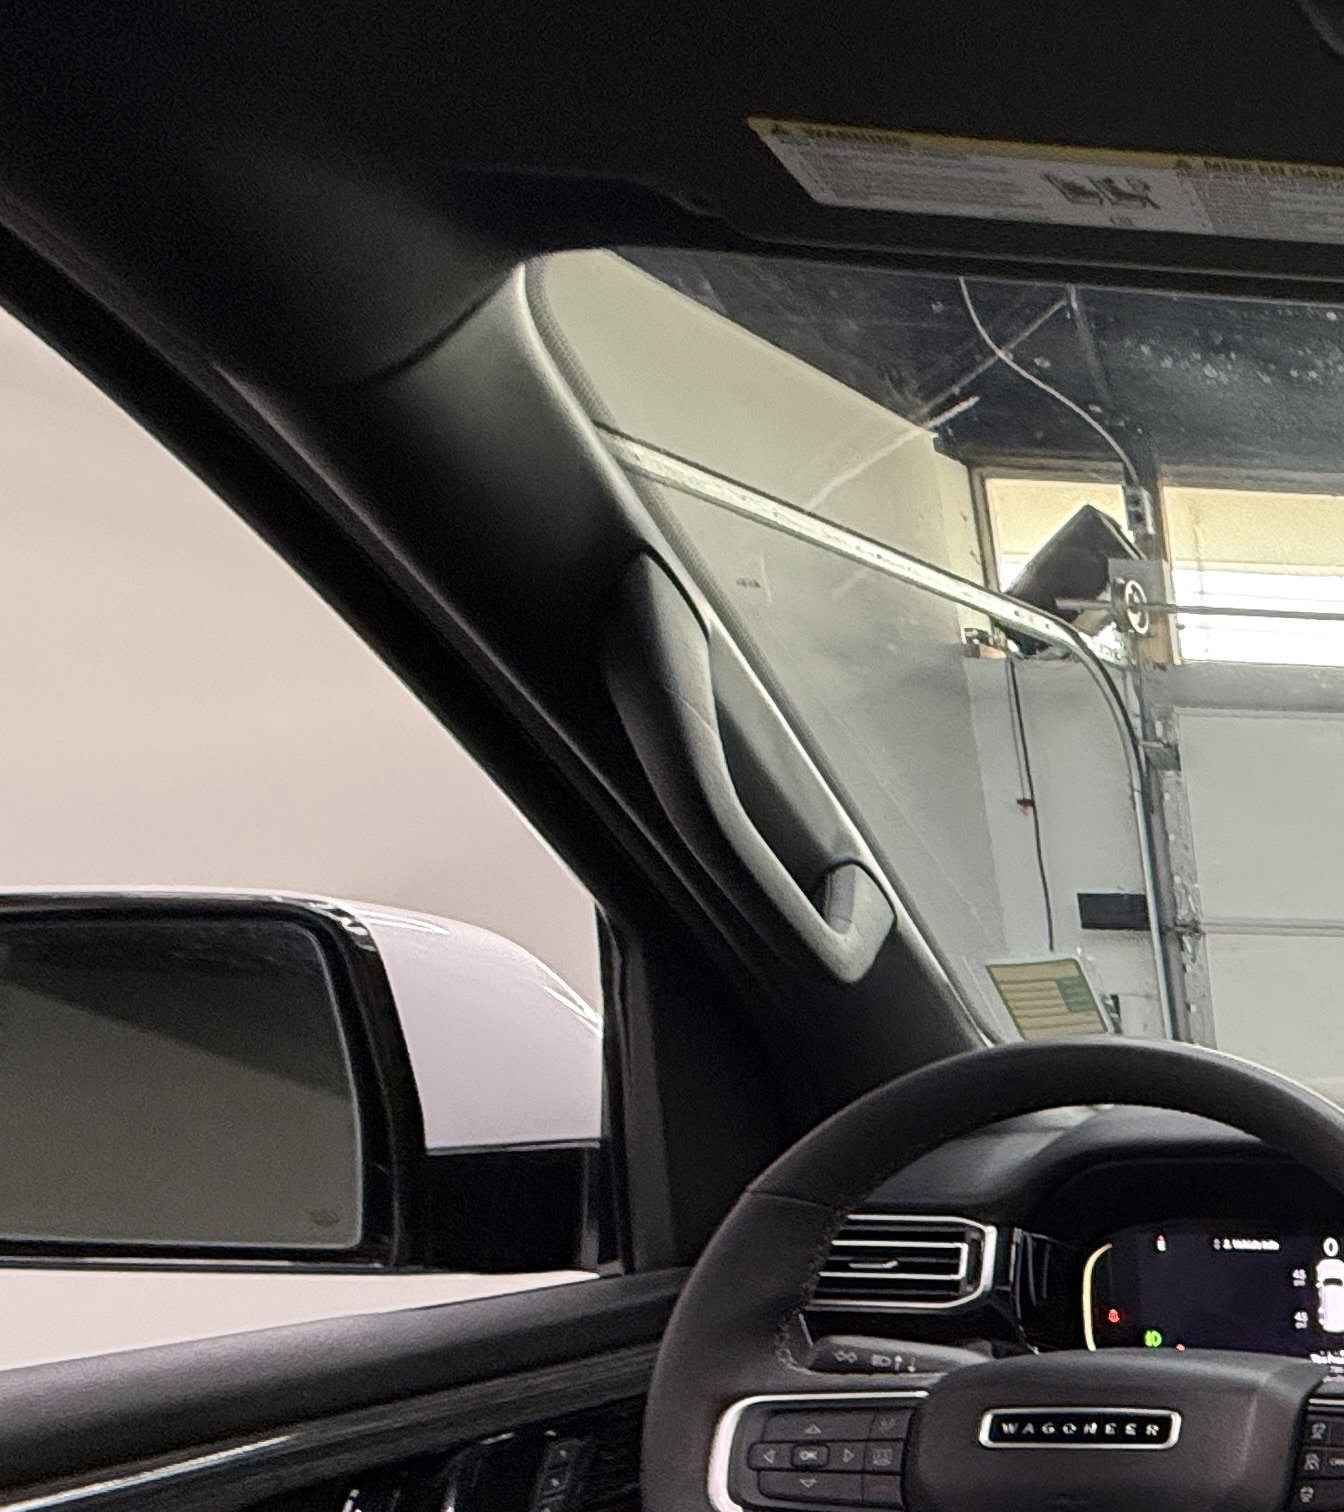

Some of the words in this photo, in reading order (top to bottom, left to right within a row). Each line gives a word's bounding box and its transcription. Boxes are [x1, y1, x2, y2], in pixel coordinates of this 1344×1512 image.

[1323, 1237, 1339, 1257] 0
[1001, 1422, 1160, 1436] WAGONEER
[800, 1451, 818, 1461] OK
